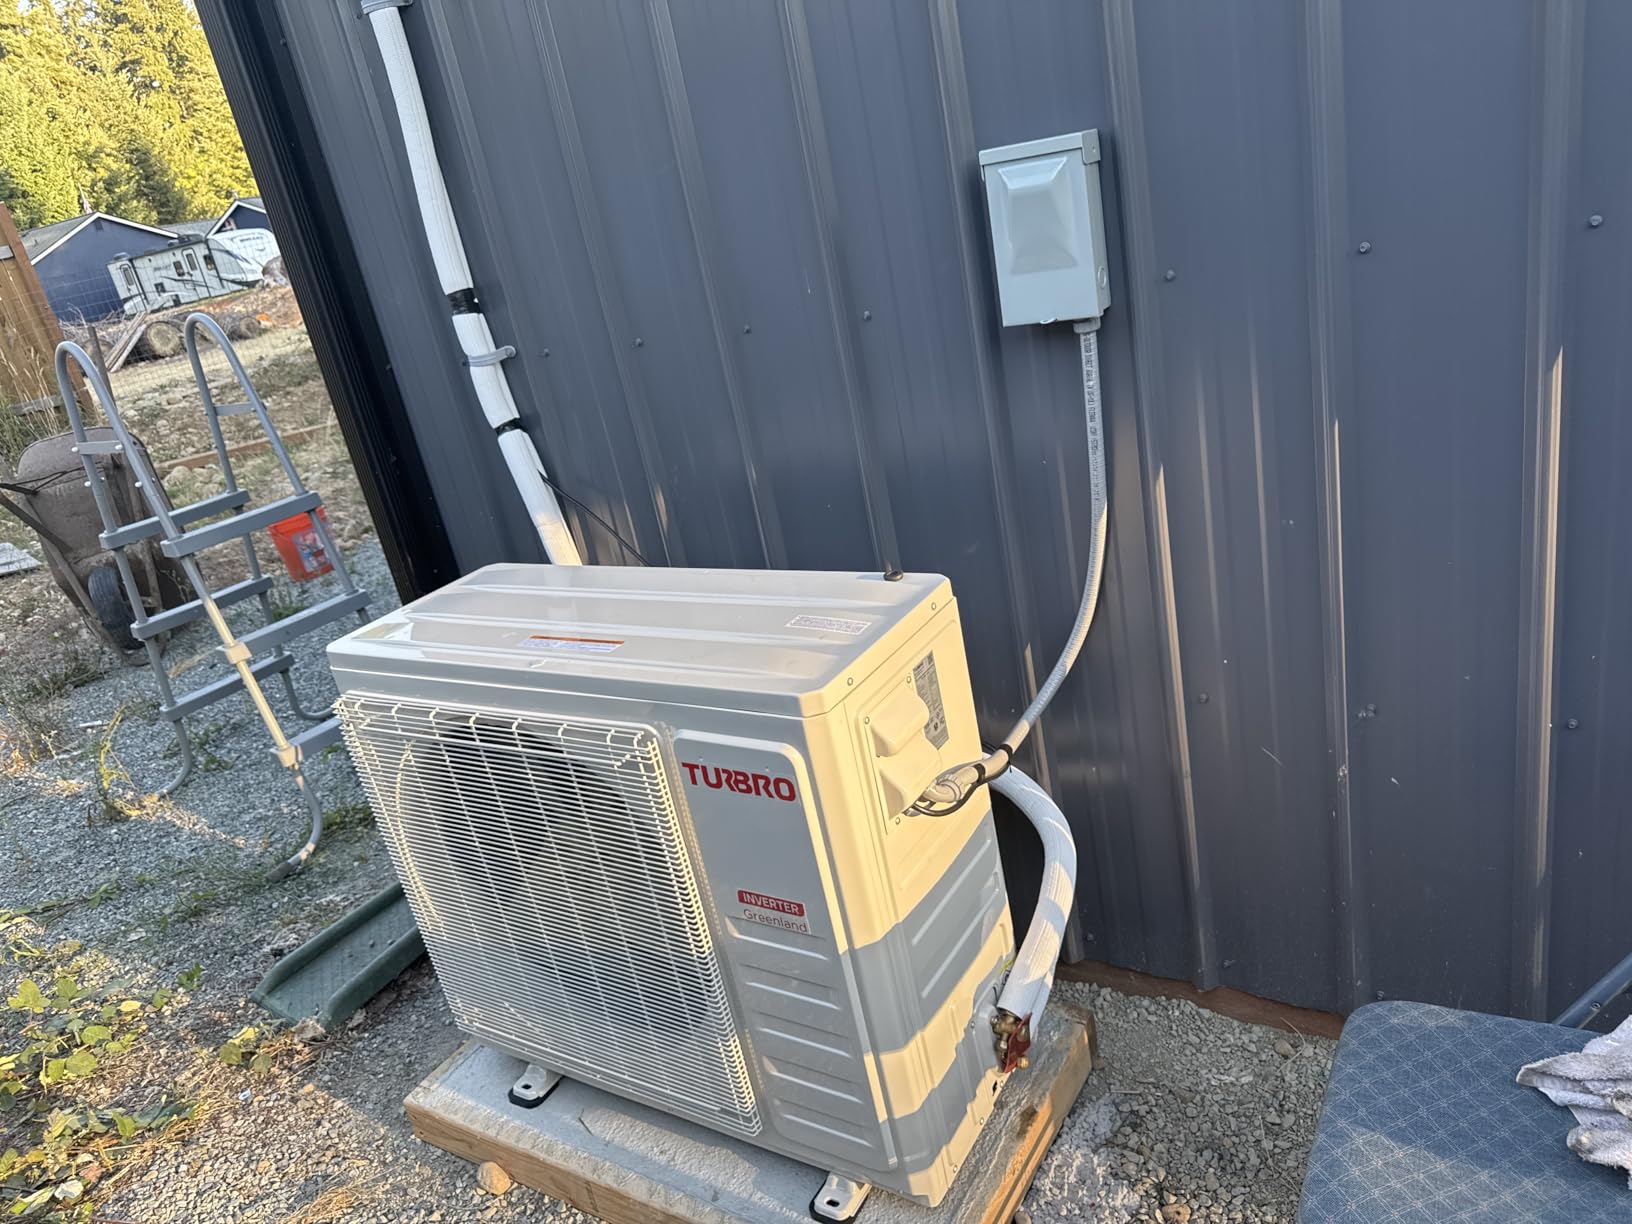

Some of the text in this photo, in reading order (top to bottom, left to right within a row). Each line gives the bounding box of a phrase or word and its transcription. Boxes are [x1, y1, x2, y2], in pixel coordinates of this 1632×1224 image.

[682, 762, 796, 802] TURBRO
[743, 892, 799, 914] INVERTER
[743, 908, 808, 933] Greenland
